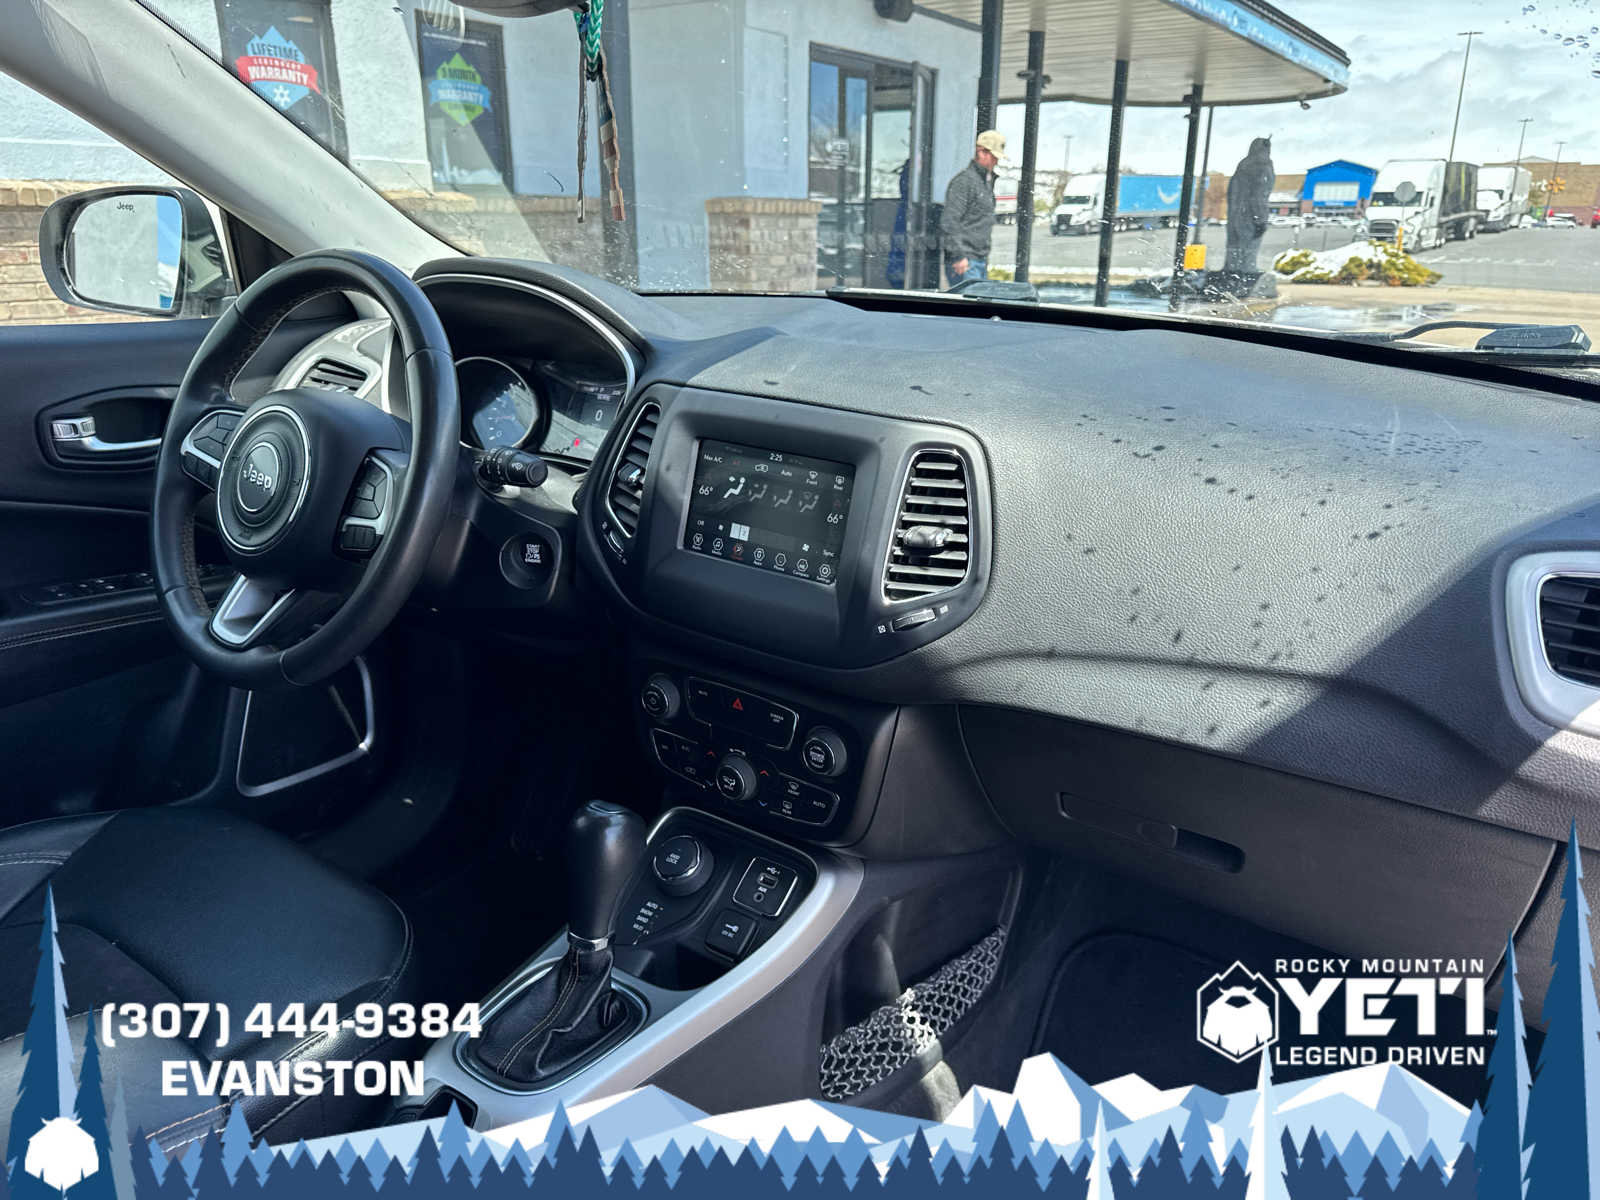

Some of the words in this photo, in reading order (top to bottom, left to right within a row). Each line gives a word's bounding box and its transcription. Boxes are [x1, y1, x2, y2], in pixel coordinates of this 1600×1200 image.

[250, 42, 300, 61] LIFETIME
[247, 66, 309, 85] WARRANTY
[116, 201, 134, 211] Jeep
[242, 463, 273, 489] Jeep
